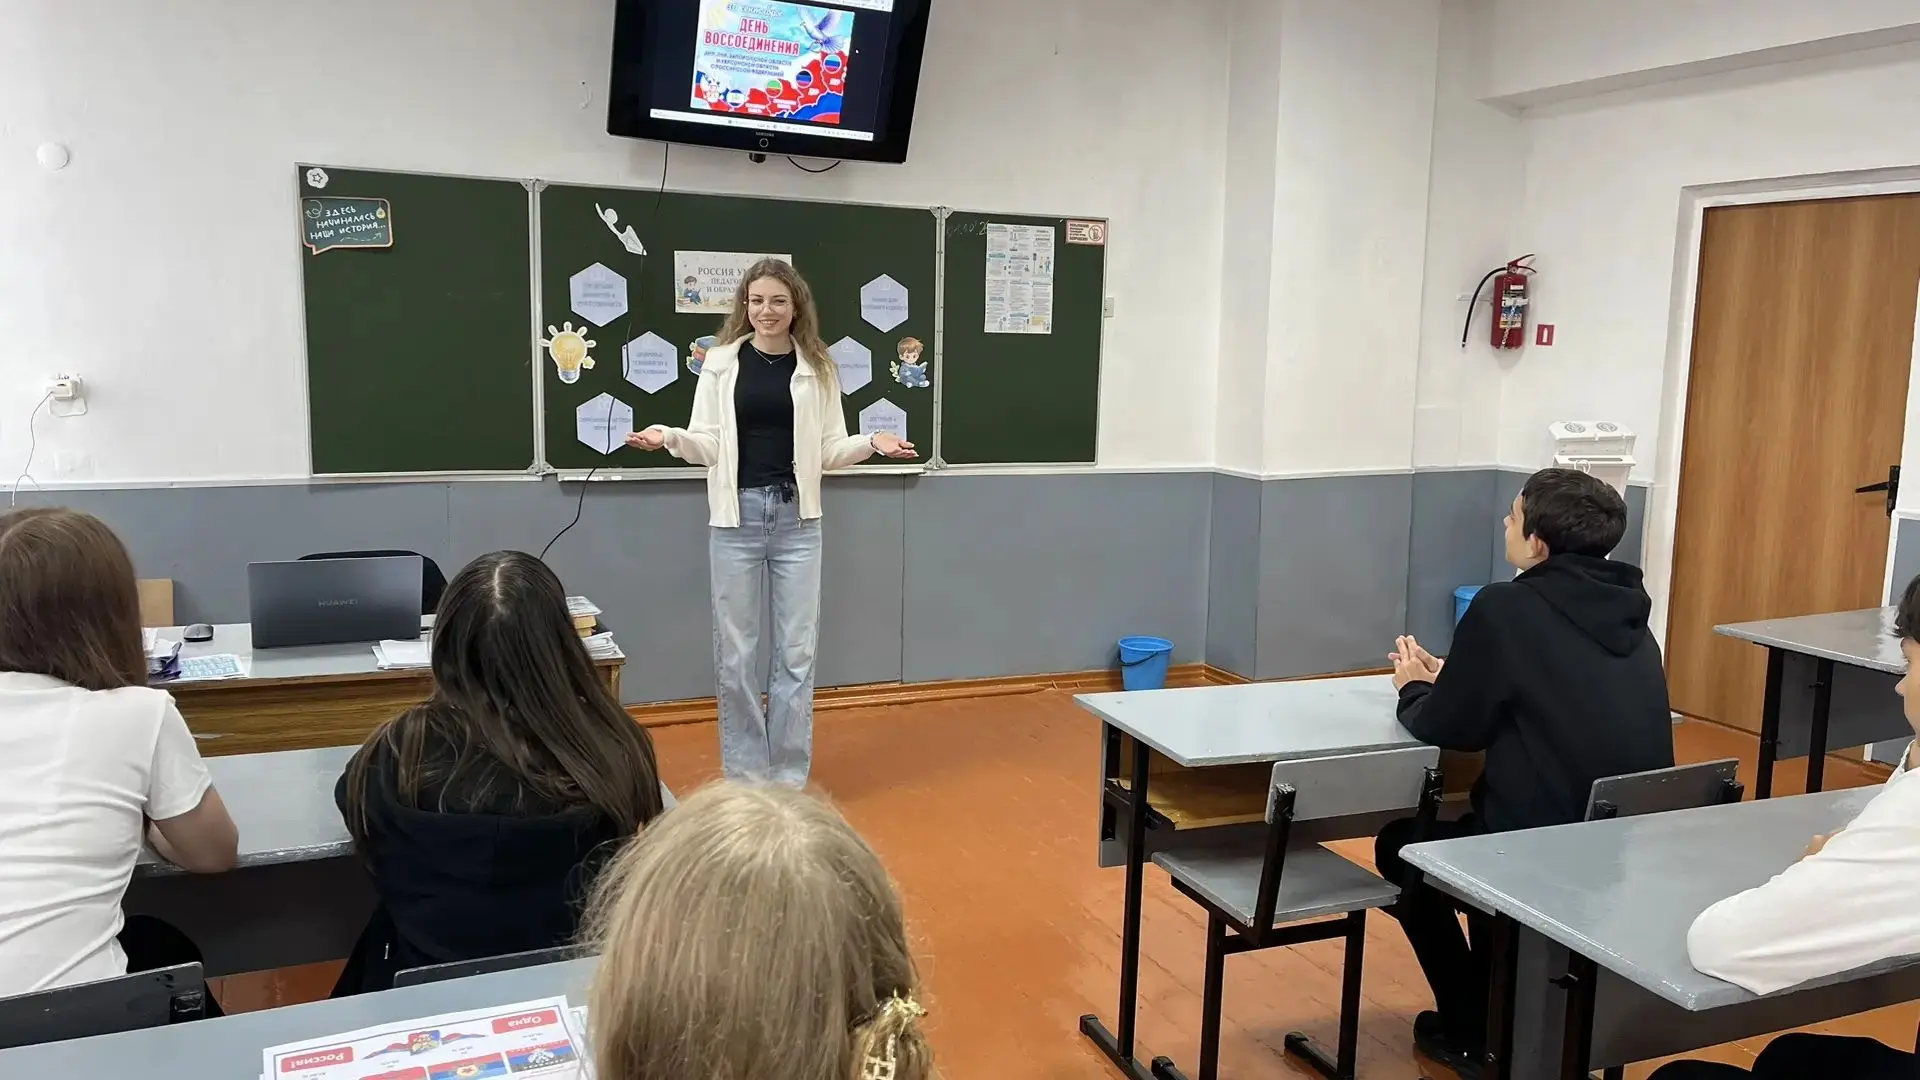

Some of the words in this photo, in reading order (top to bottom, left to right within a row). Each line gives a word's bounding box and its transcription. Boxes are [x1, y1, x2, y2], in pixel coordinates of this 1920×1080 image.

[740, 18, 769, 34] ДЕНЬ
[704, 31, 800, 55] ВОССОЕДИНЕНИЯ
[325, 205, 357, 217] ЗДЕСЬ
[316, 212, 376, 229] НАЧИНАЛАСЬ
[310, 229, 335, 240] НАША
[698, 267, 734, 276] РОССИЯ
[318, 599, 358, 607] HUAWEI
[507, 1016, 542, 1028] Одна
[290, 1052, 345, 1069] Россия!
